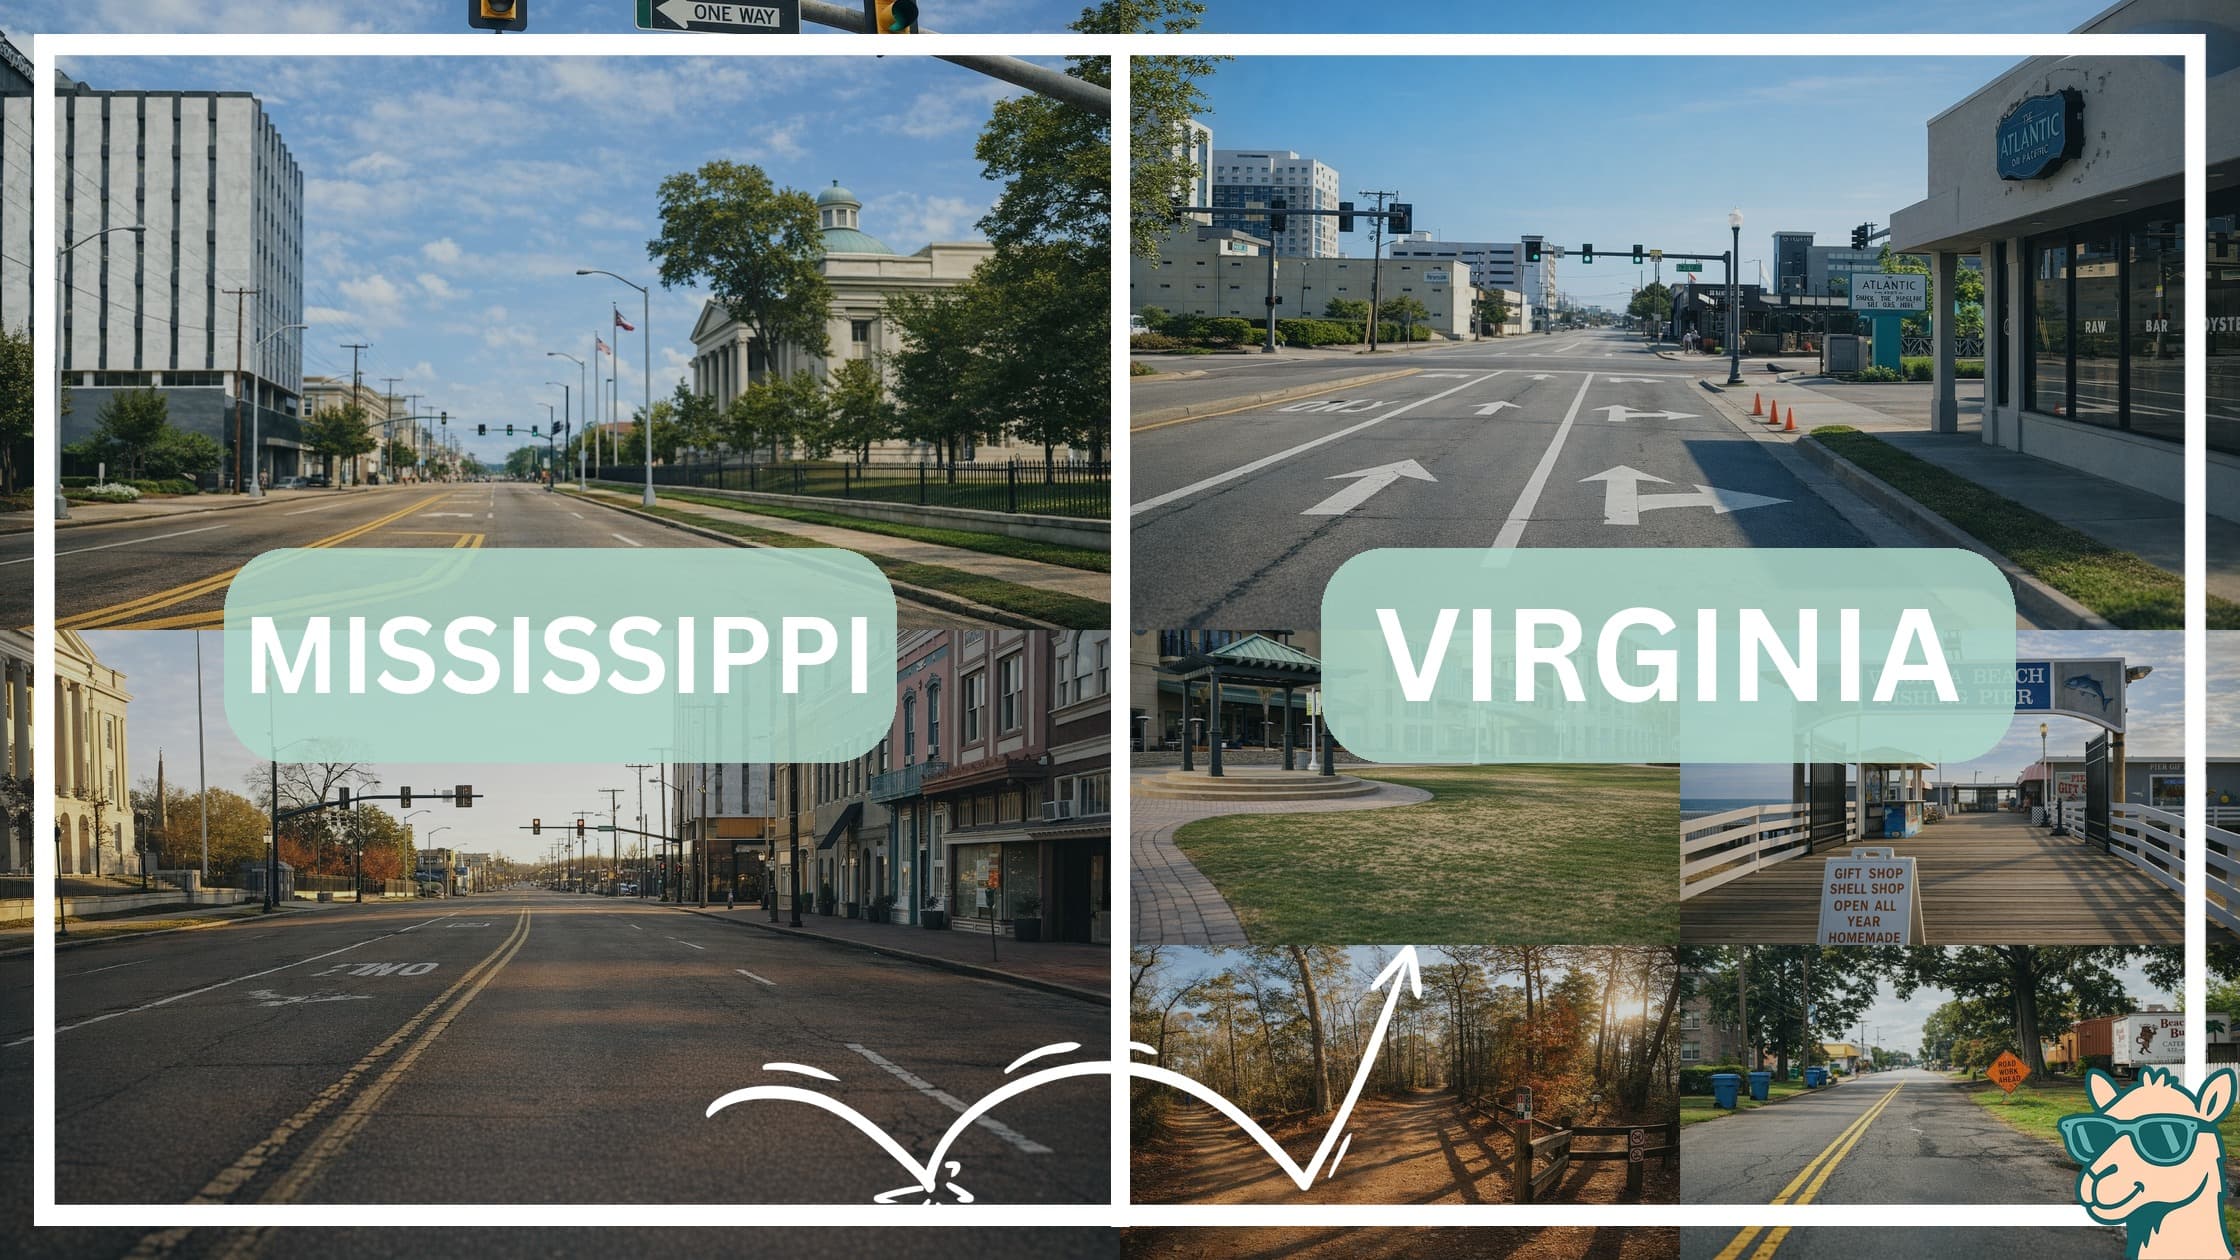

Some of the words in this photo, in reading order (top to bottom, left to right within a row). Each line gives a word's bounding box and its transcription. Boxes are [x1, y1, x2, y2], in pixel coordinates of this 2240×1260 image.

[694, 4, 732, 22] ONE
[739, 7, 776, 25] WAY
[2023, 111, 2033, 125] THE
[2000, 111, 2060, 158] ATLANTIC
[1862, 279, 1917, 291] ATLANTIC
[2085, 320, 2107, 333] RAW
[2145, 319, 2168, 333] BAR
[1973, 667, 2045, 684] BEACH
[1979, 688, 2034, 705] PIER
[2071, 774, 2086, 783] PIE
[2058, 782, 2079, 794] GIFT
[1834, 867, 1862, 880] GIFT
[1869, 867, 1904, 880] SHOP
[1830, 883, 1867, 895] SHELL
[1871, 883, 1905, 895] SHOP
[1833, 900, 1869, 912] OPEN
[1874, 900, 1897, 912] ALL
[1847, 916, 1881, 928] YEAR
[1828, 932, 1901, 943] HOMEMADE
[2160, 1018, 2185, 1029] Beac
[2170, 1028, 2185, 1038] Bu
[1998, 1059, 2017, 1068] ROAD
[1998, 1068, 2019, 1076] WORK
[1998, 1075, 2021, 1083] AHEAD
